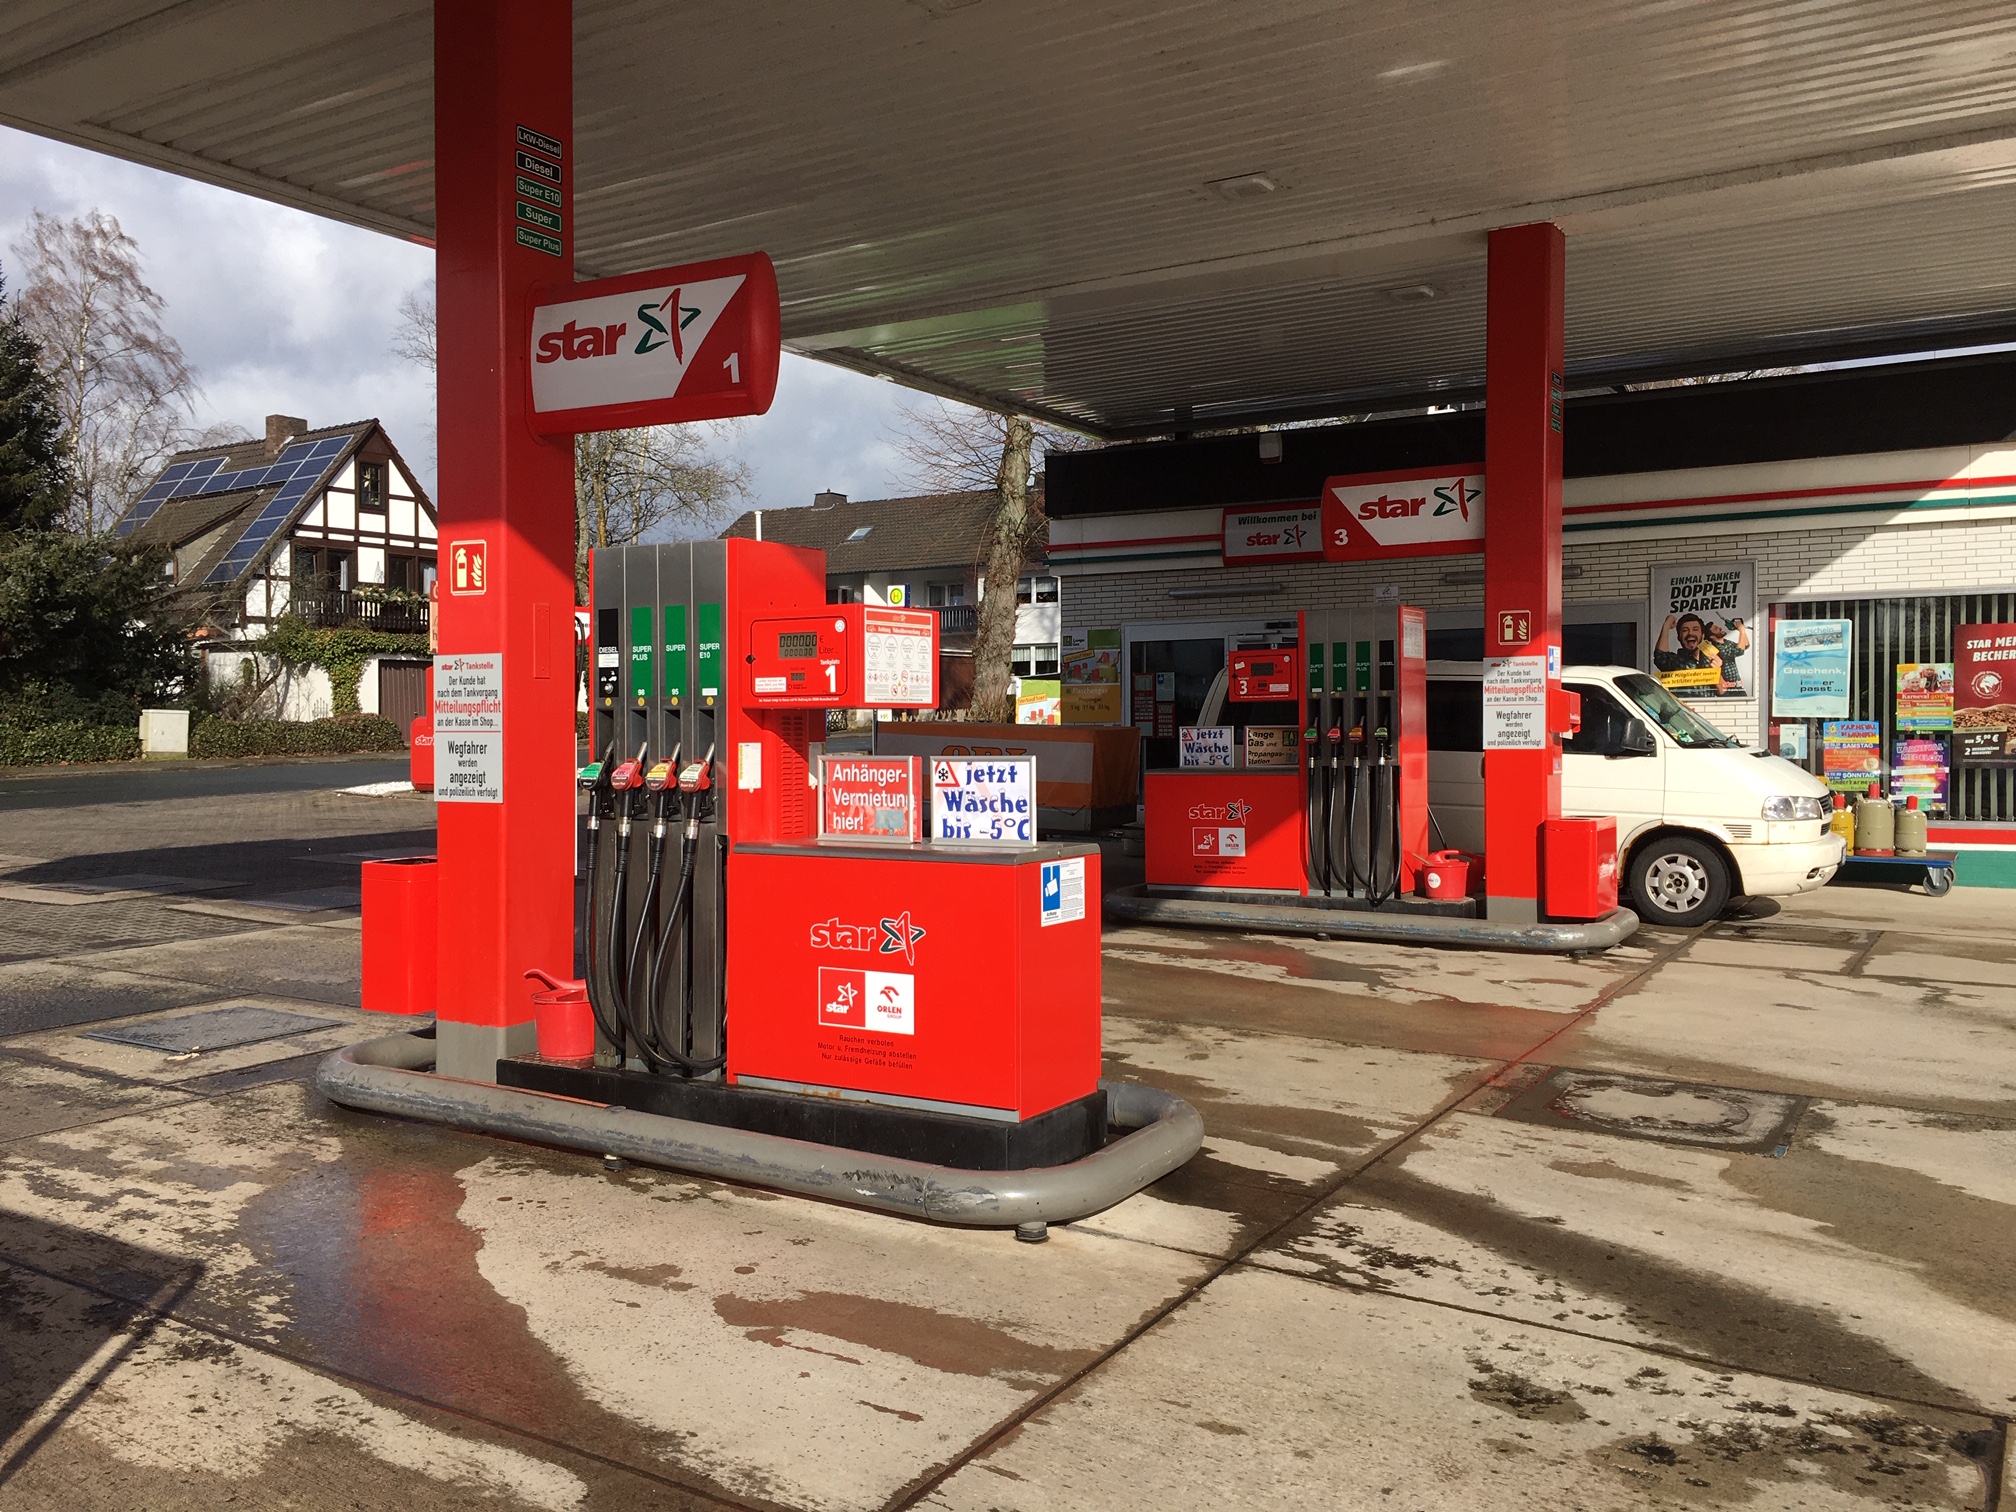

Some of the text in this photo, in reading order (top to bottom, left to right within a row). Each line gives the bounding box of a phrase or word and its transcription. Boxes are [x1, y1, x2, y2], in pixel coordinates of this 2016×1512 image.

[518, 131, 560, 154] LKW-Diesel
[525, 157, 553, 177] Diesel
[518, 180, 560, 203] Super E10
[525, 207, 553, 224] Super
[518, 230, 560, 251] Super Plus
[536, 319, 627, 363] star
[722, 352, 740, 384] 1
[1357, 495, 1427, 520] star
[1237, 510, 1317, 525] Willkommen bei
[1246, 531, 1280, 547] star
[1333, 528, 1349, 546] 3
[1670, 571, 1740, 586] EINMAL TANKEN
[1670, 580, 1741, 599] DOPPELT
[1670, 595, 1738, 613] SPAREN!
[1796, 627, 1834, 636] Gutschein
[599, 646, 618, 654] DIESEL
[632, 645, 653, 653] SUPER
[665, 644, 686, 652] SUPER
[699, 643, 720, 651] SUPER
[1966, 639, 1992, 649] STAR
[632, 653, 649, 661] PLUS
[699, 651, 711, 660] E10
[1972, 649, 2016, 662] BECHER
[466, 661, 494, 670] Tankstelle
[1783, 667, 1846, 675] Geschenk,
[448, 676, 487, 686] Der Kunde hat
[824, 665, 836, 693] 1
[1510, 677, 1542, 685] Tankvorgang
[437, 687, 498, 699] nach dem Tankvorgang
[637, 688, 645, 696] 98
[672, 688, 679, 696] 95
[1239, 680, 1248, 695] 3
[1484, 685, 1545, 695] Mitteilungspflicht
[435, 700, 501, 717] Mitteilungspflicht
[445, 717, 454, 726] der
[455, 717, 471, 726] Kasse
[472, 716, 479, 726] im
[1496, 710, 1532, 722] Wegfahrer
[415, 735, 433, 746] star
[1196, 729, 1224, 741] jetzt
[1497, 729, 1531, 740] angezeigt
[447, 740, 488, 758] Wegfahrer
[1184, 742, 1229, 753] Wäsche
[1248, 739, 1264, 747] Gas
[1896, 743, 1944, 754] KARNEVAL
[1964, 747, 1971, 756] 2
[458, 758, 478, 767] werden
[1183, 755, 1200, 766] bis
[449, 769, 487, 787] angezeigt
[832, 763, 907, 786] Anhänger-
[963, 762, 1018, 786] jetzt
[438, 786, 498, 800] und polizeilich verfolgt
[942, 788, 1029, 814] Wäsche
[1188, 803, 1226, 820] star
[832, 813, 865, 831] hier!
[942, 816, 971, 839] bis
[810, 917, 877, 951] star
[826, 1001, 849, 1014] star
[877, 1005, 902, 1014] ORLEN
[839, 1034, 894, 1047] Rauchen verboten
[817, 1042, 834, 1051] Motor
[844, 1046, 887, 1057] Fremdheizung
[889, 1049, 917, 1060] abstellen
[834, 1054, 862, 1064] zulässige
[864, 1056, 886, 1066] Gefäße
[888, 1059, 913, 1070] befüllen
